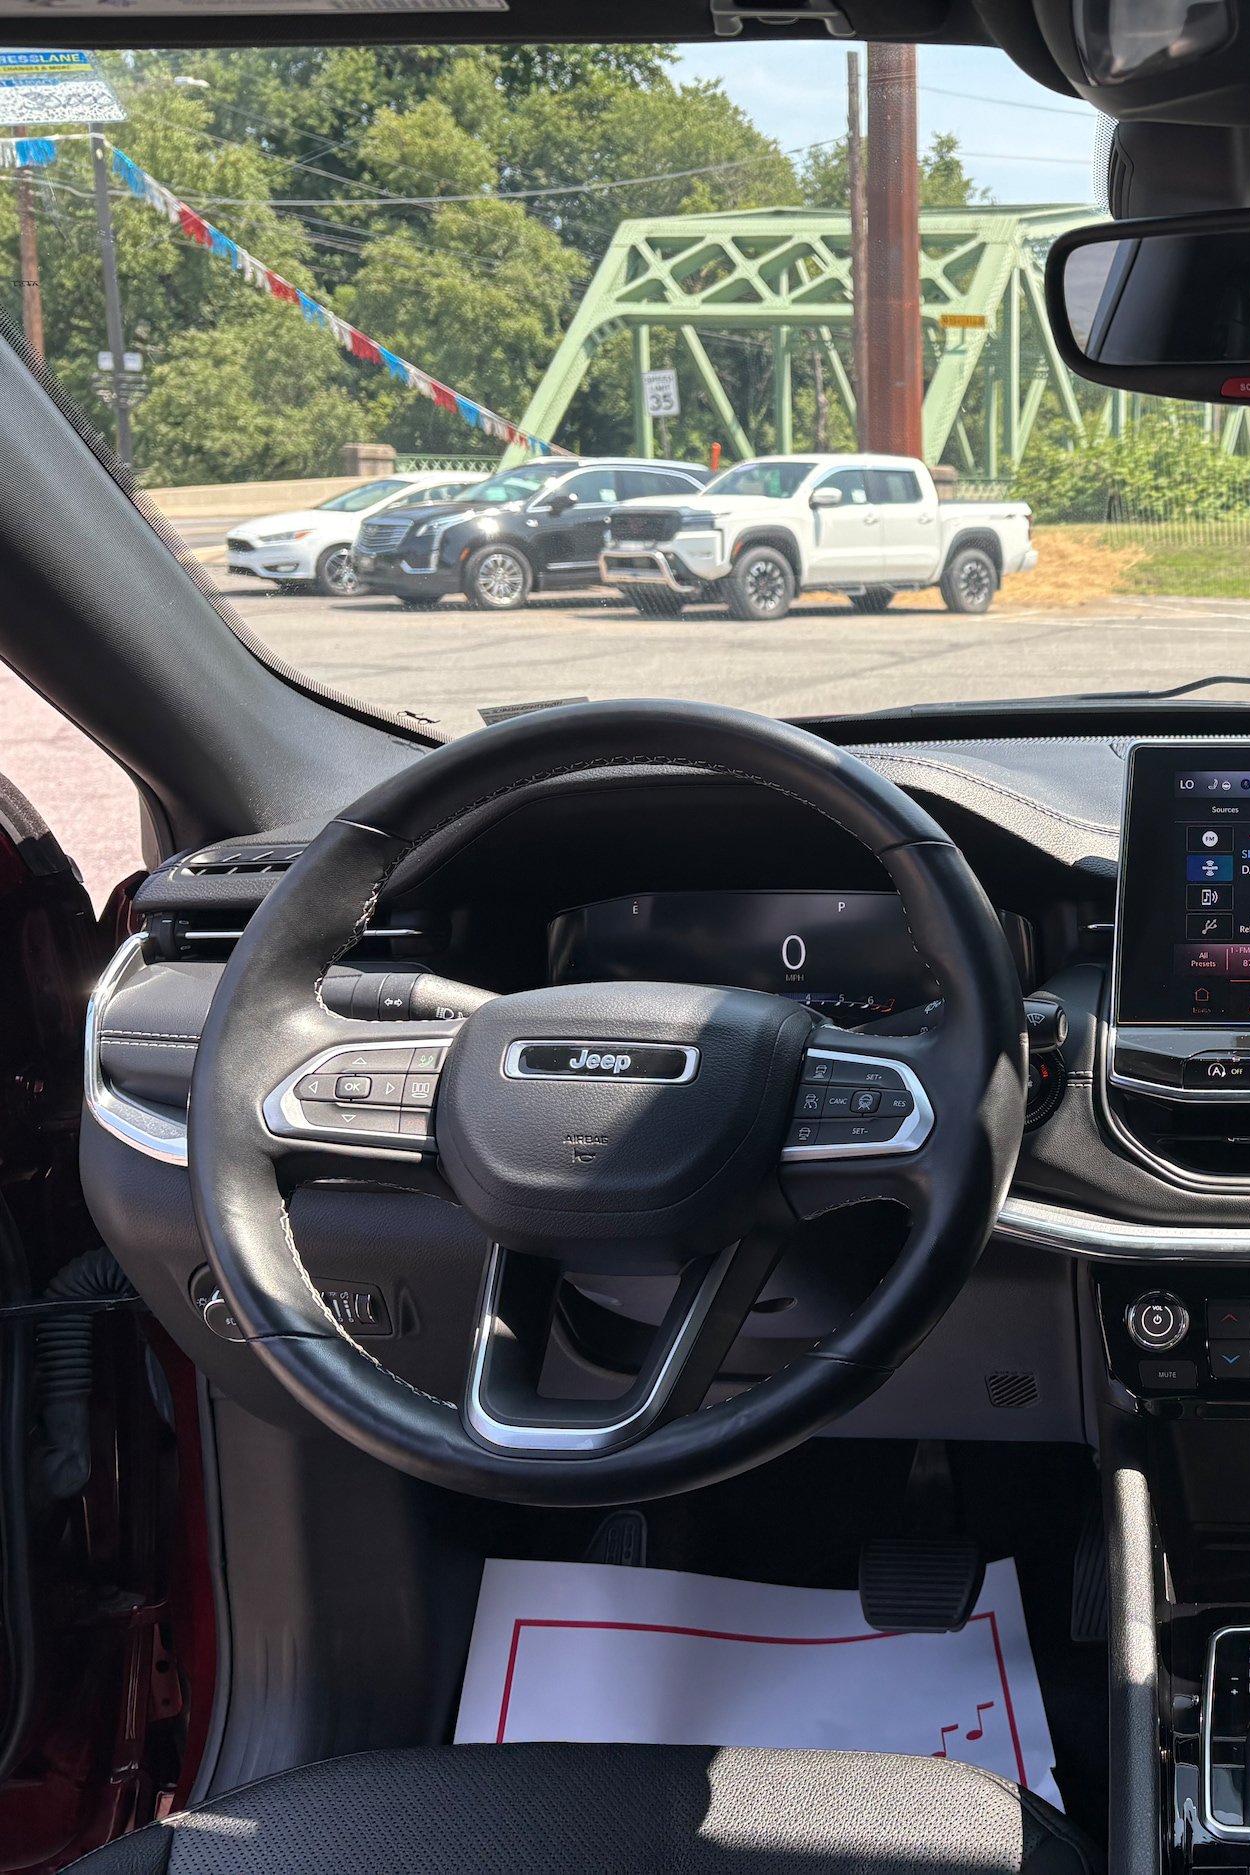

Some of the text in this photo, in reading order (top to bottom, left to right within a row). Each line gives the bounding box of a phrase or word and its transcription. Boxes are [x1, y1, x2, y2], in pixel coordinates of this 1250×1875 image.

[649, 393, 674, 411] 35
[1180, 780, 1194, 789] LO
[837, 901, 846, 912] P
[781, 934, 807, 970] 0
[785, 974, 804, 982] MPH
[867, 996, 874, 1004] 6
[569, 1050, 632, 1074] Jeep
[344, 1082, 360, 1092] OK
[828, 1097, 849, 1105] CANC
[892, 1100, 906, 1108] RES
[563, 1135, 609, 1146] AIRBAG
[1158, 1371, 1177, 1379] MUTE
